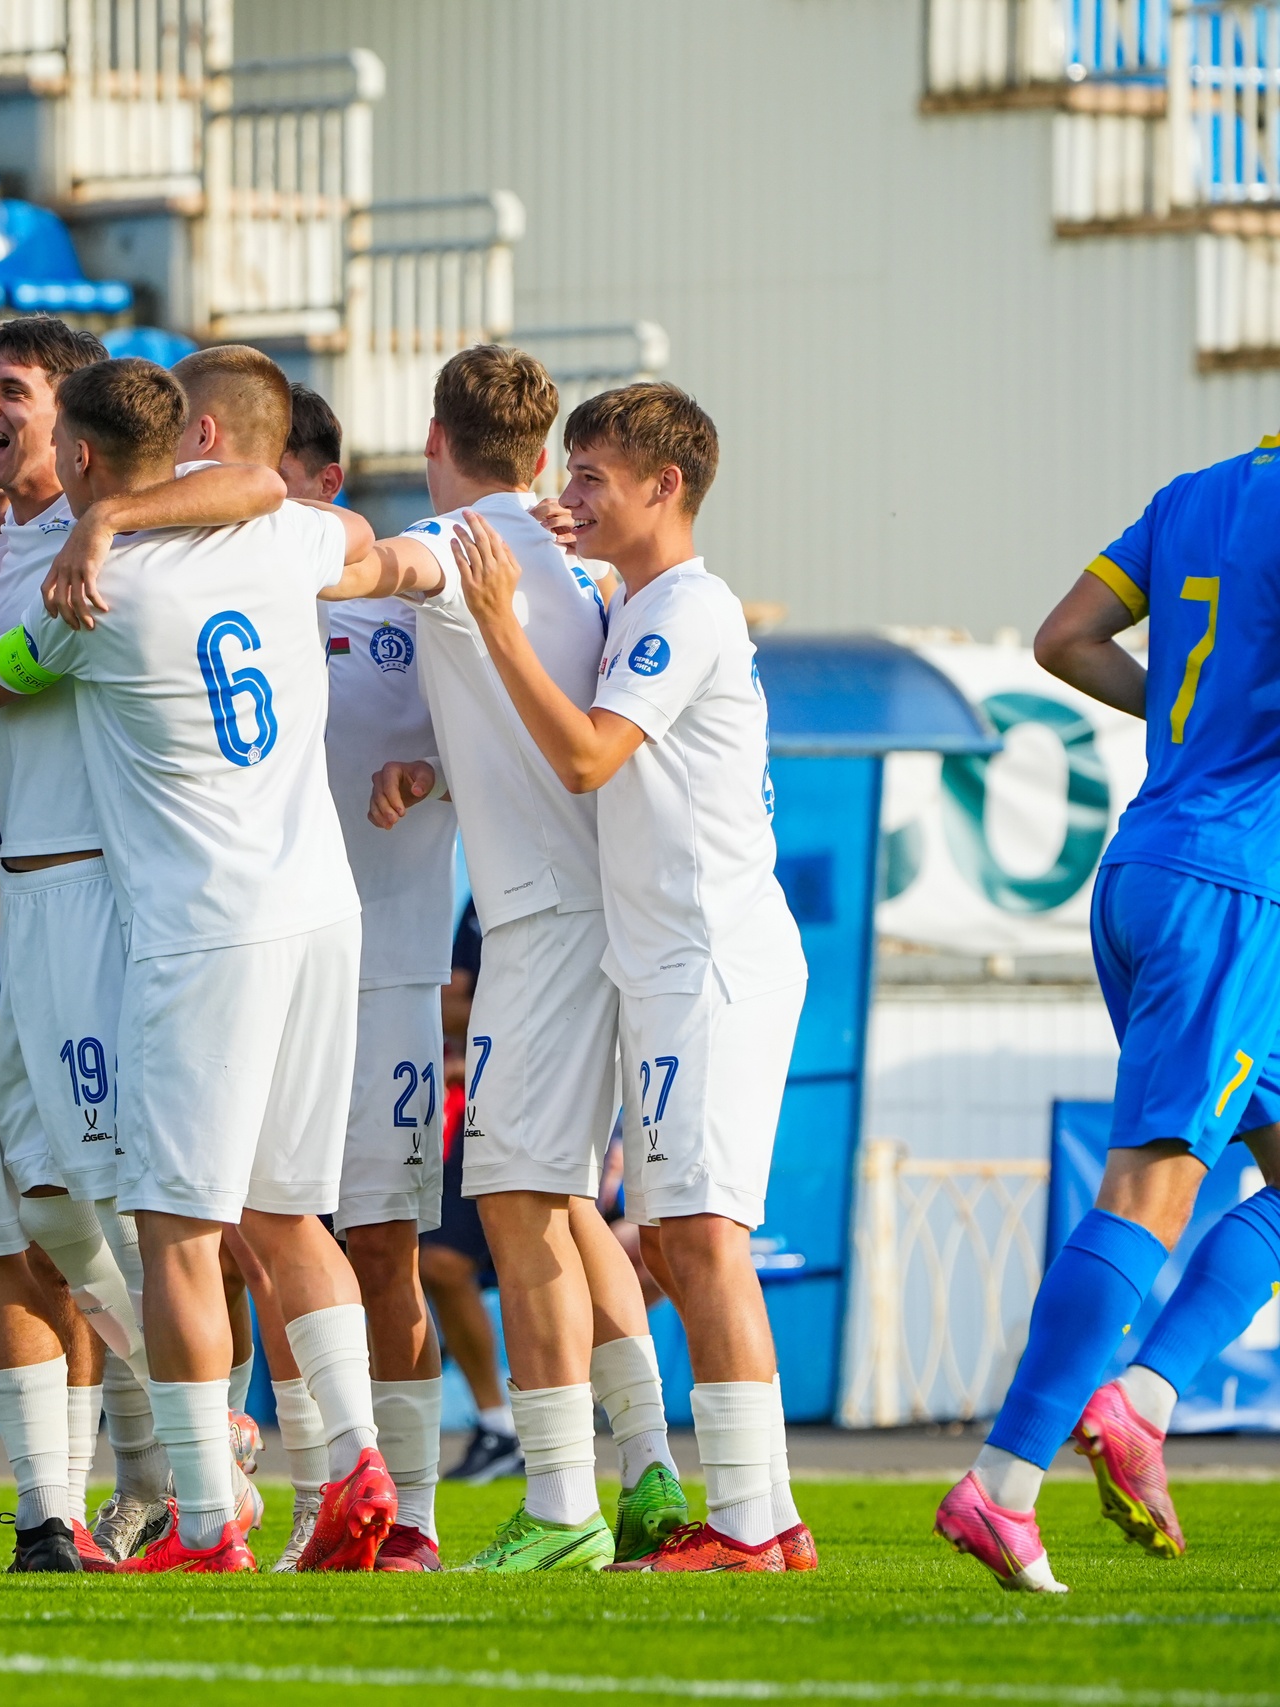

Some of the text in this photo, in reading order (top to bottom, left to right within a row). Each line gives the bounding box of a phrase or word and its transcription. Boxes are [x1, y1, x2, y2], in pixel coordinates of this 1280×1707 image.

[196, 610, 278, 767] 6
[1170, 576, 1220, 744] 7
[60, 1037, 109, 1107] 19
[393, 1061, 435, 1127] 21
[469, 1035, 492, 1101] 7
[640, 1056, 680, 1127] 27
[1215, 1048, 1255, 1118] 7
